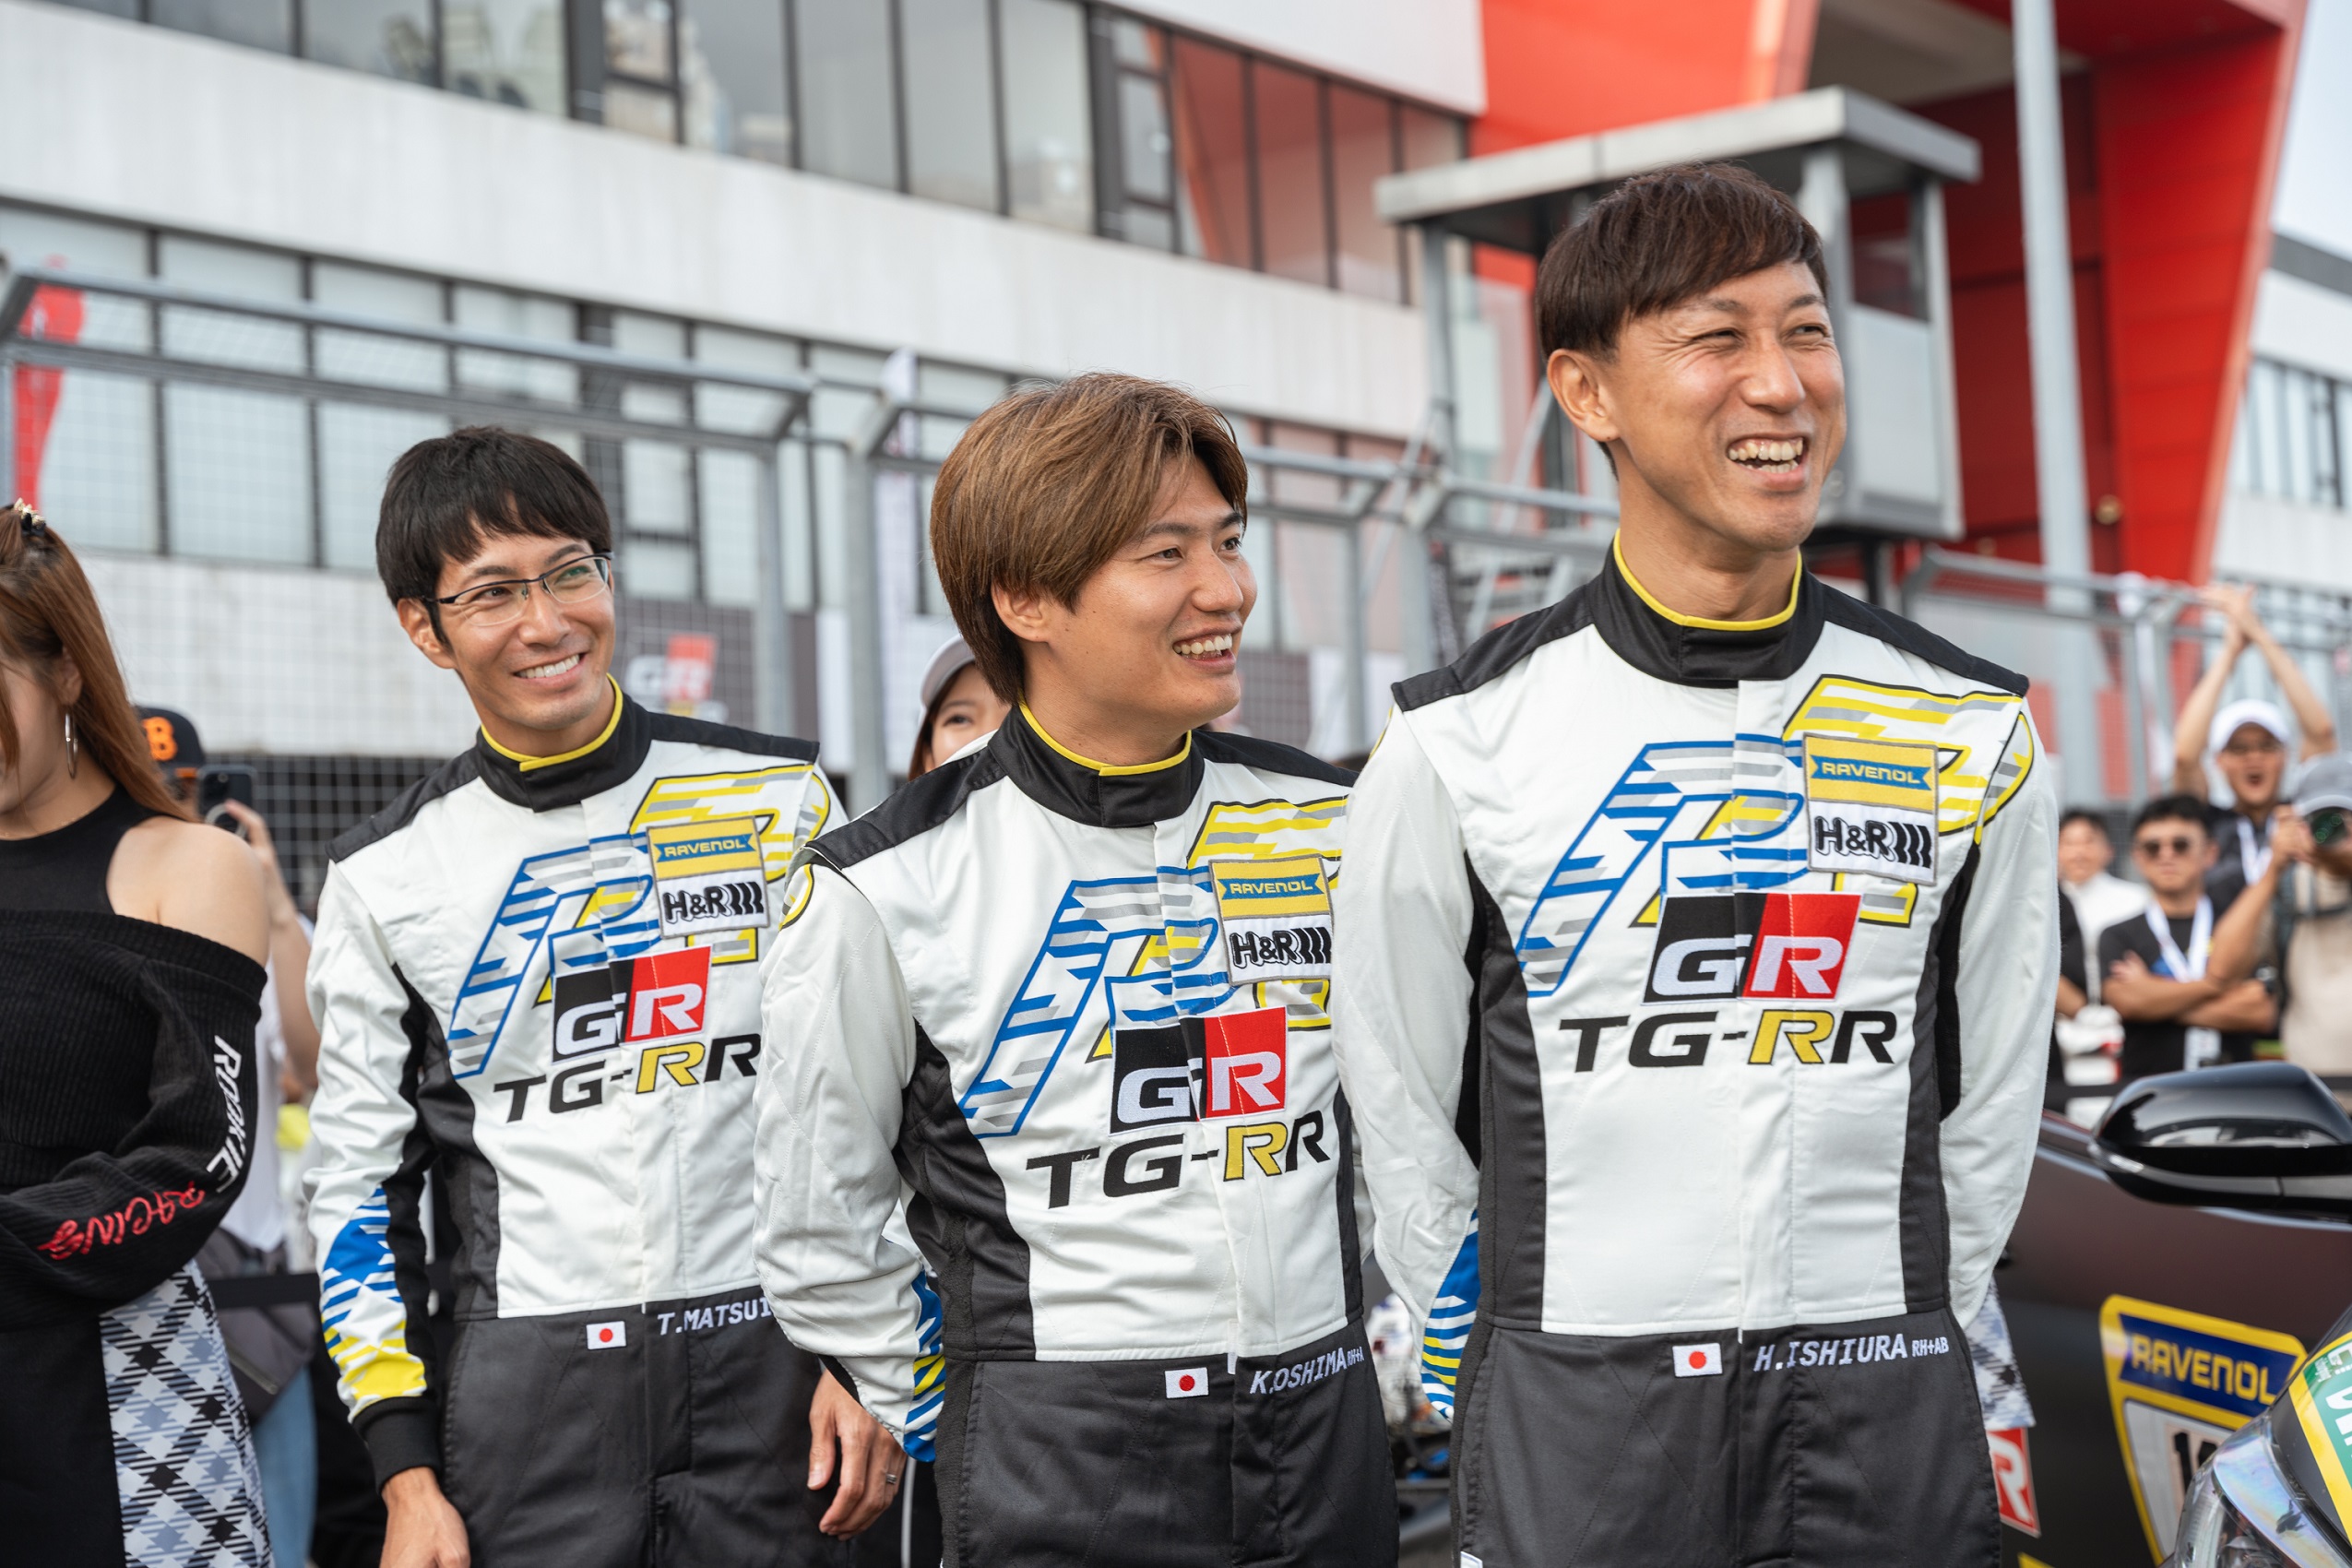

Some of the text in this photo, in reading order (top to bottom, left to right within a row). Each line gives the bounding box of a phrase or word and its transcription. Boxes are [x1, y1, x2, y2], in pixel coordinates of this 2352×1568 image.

[142, 717, 177, 761] B
[1822, 762, 1921, 784] RAVENOL
[664, 839, 746, 858] RAVENOL
[1814, 815, 1895, 861] H&R
[663, 885, 732, 924] H&R
[1229, 880, 1313, 895] RAVENOL
[1229, 931, 1302, 968] H&R
[1652, 934, 1844, 996] GR
[555, 983, 703, 1055] GR
[1559, 1009, 1897, 1073] TG-RR
[493, 1033, 761, 1123] TG-RR
[1117, 1051, 1281, 1124] GR
[38, 1035, 246, 1260] ROOKIE RACING
[1026, 1110, 1331, 1210] TG-RR
[657, 1297, 772, 1336] T.MATSUI
[1250, 1348, 1347, 1394] K.OSHIMA
[1753, 1334, 1949, 1372] H.ISHIURA RH+AB
[2131, 1334, 2276, 1407] RAVENOL
